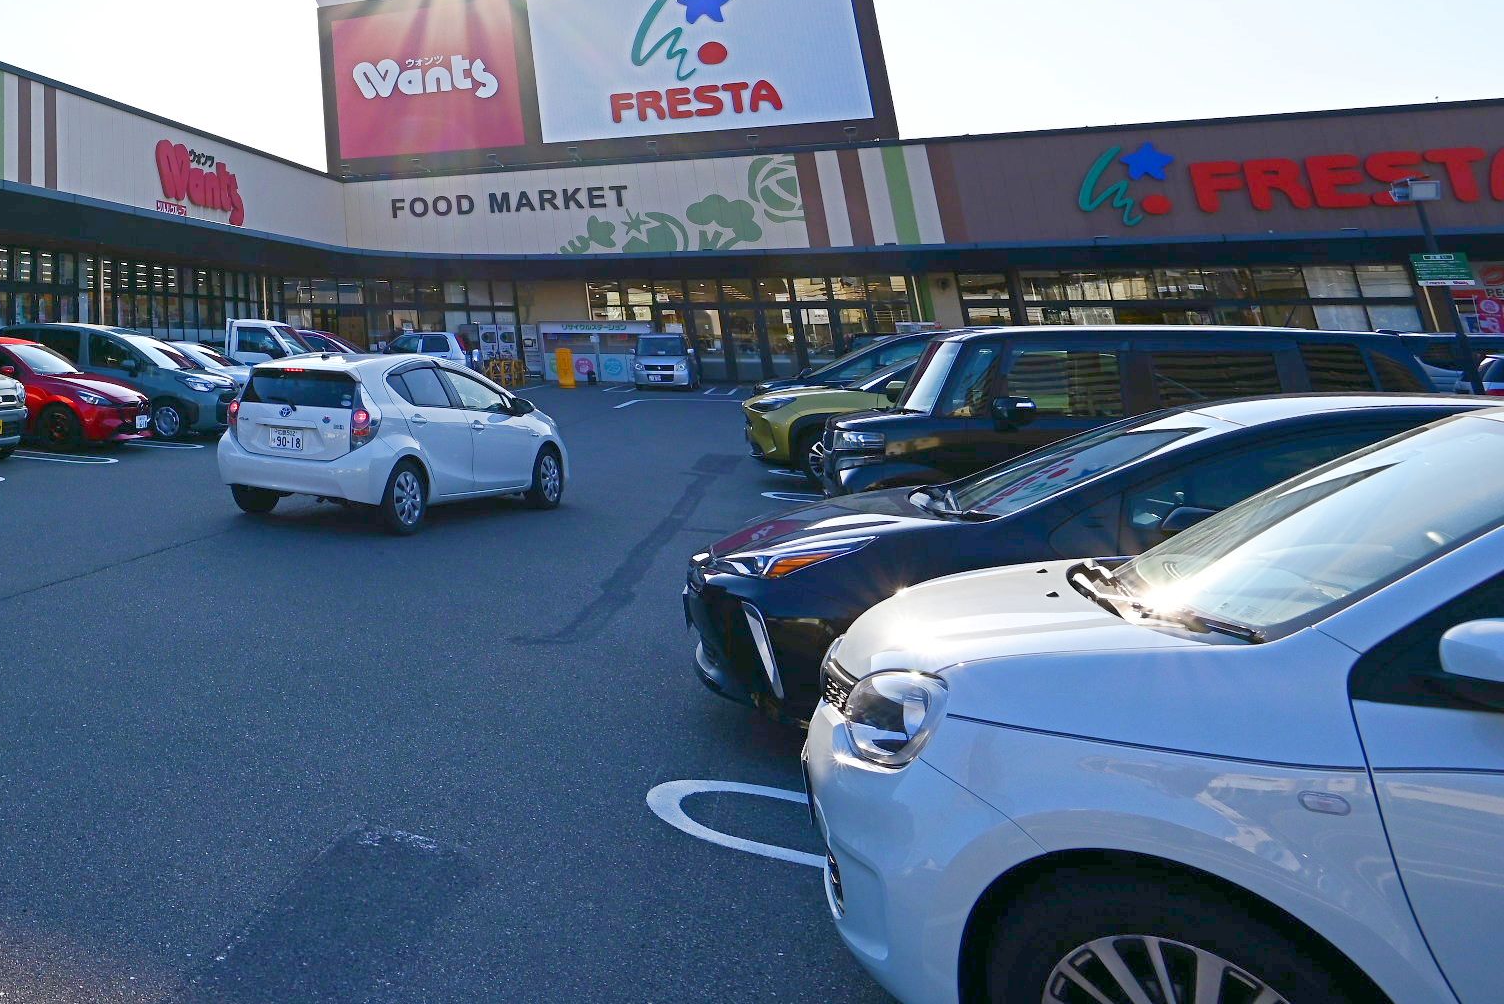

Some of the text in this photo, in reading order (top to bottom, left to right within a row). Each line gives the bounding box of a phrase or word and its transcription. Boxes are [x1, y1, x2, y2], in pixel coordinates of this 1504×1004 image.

[352, 54, 499, 100] Wants
[406, 55, 444, 68] ウォンツ
[609, 79, 783, 124] FRESTA
[155, 139, 245, 226] Wants
[391, 185, 628, 219] FOOD MARKET
[1189, 146, 1504, 213] FREST
[561, 323, 627, 331] リサイクルステーション
